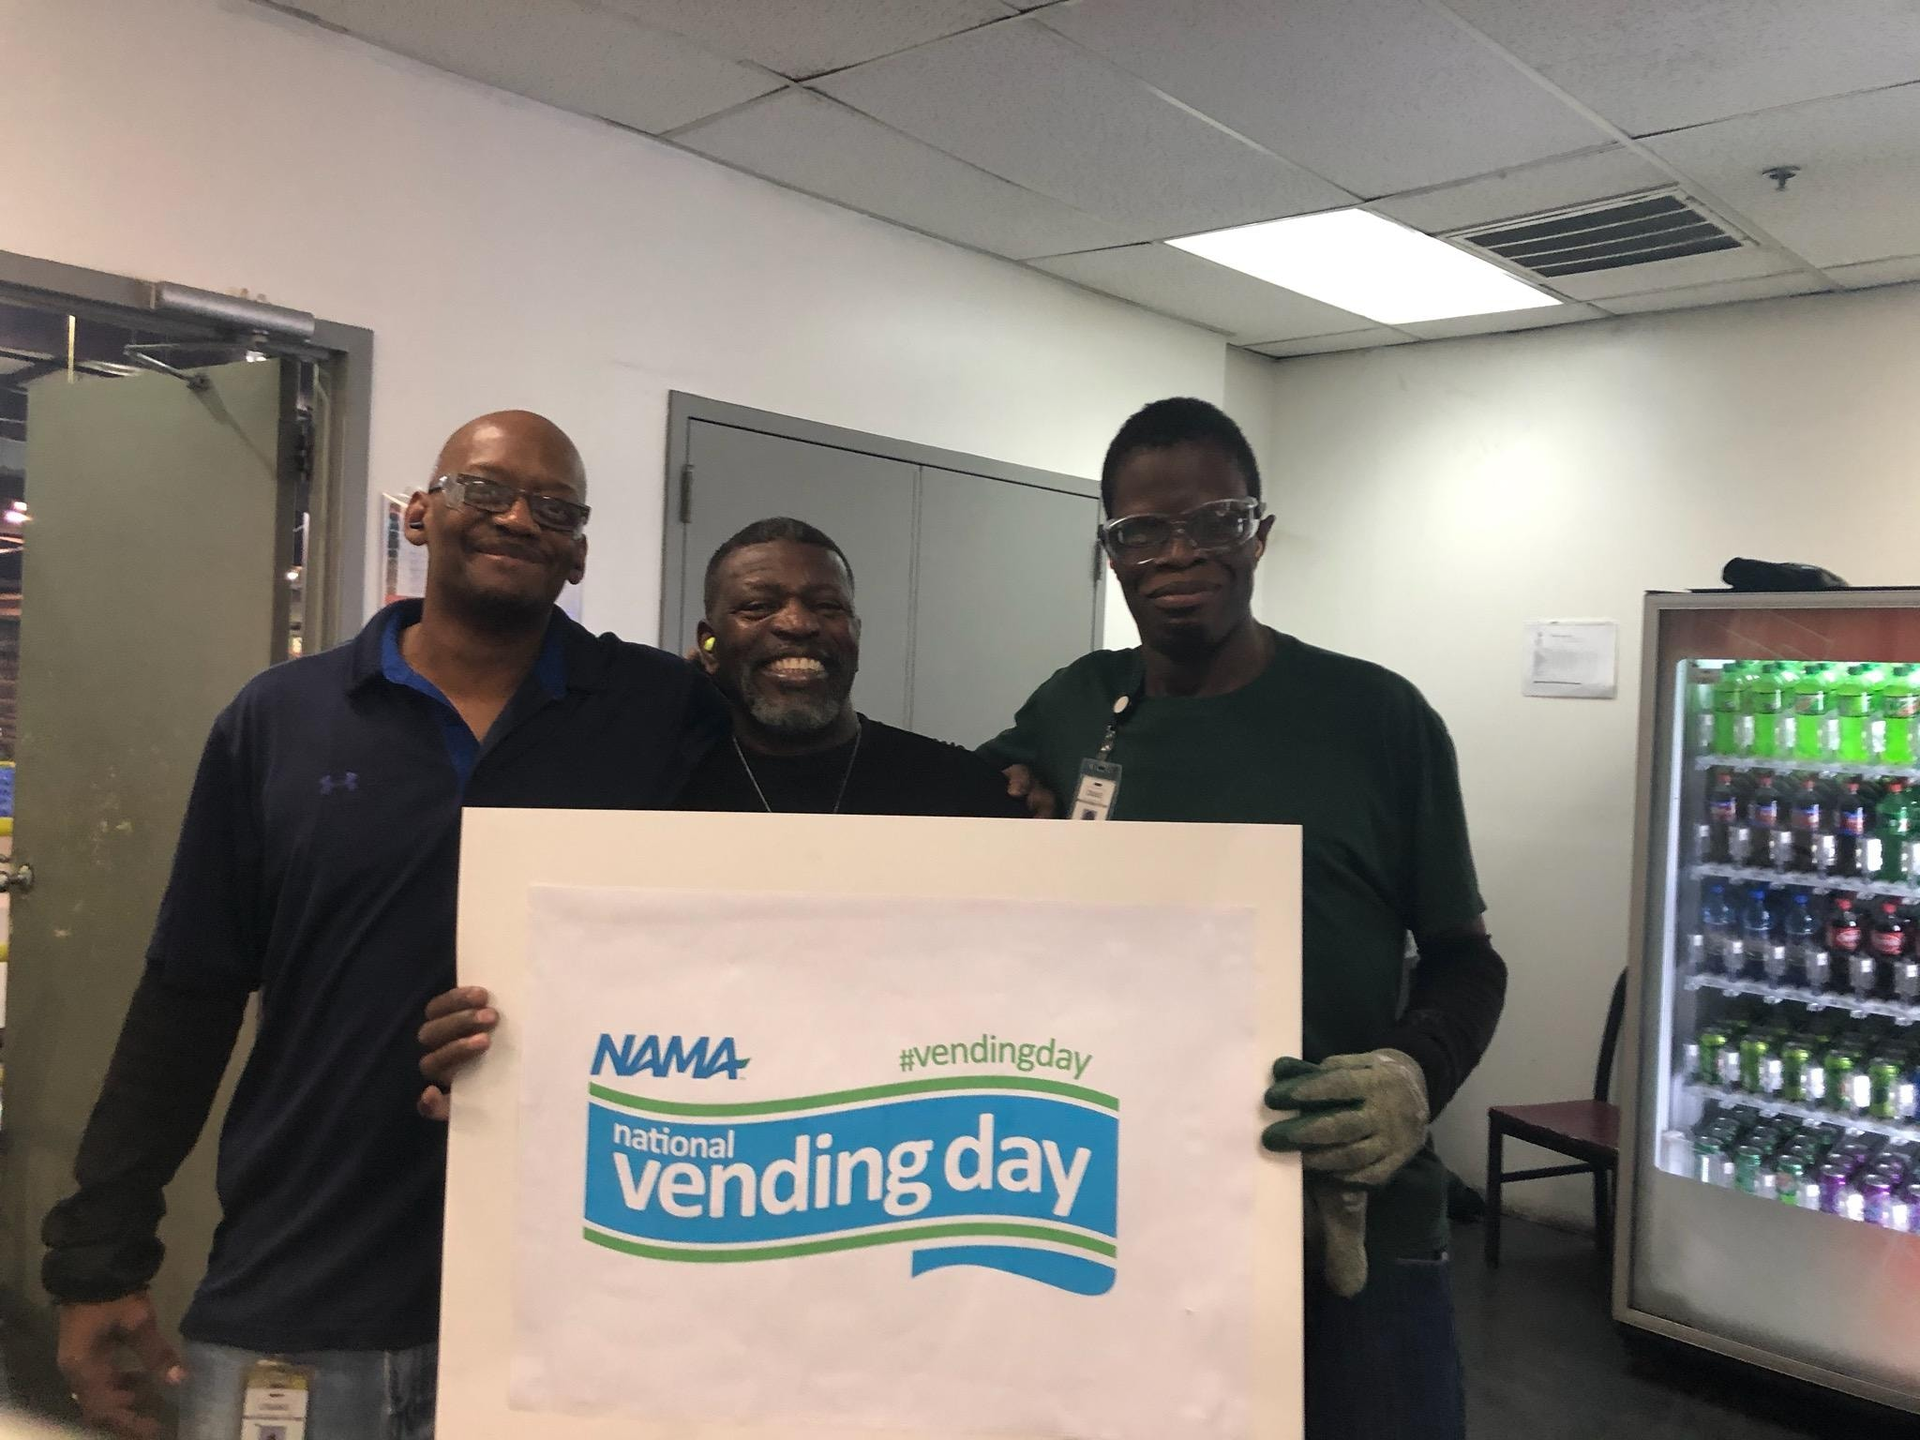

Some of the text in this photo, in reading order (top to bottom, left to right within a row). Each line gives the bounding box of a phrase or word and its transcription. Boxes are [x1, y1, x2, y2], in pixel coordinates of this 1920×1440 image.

[590, 1033, 751, 1080] NAMA
[899, 1034, 1093, 1080] #vendingday
[613, 1122, 734, 1159] national
[612, 1113, 1092, 1218] vending day
